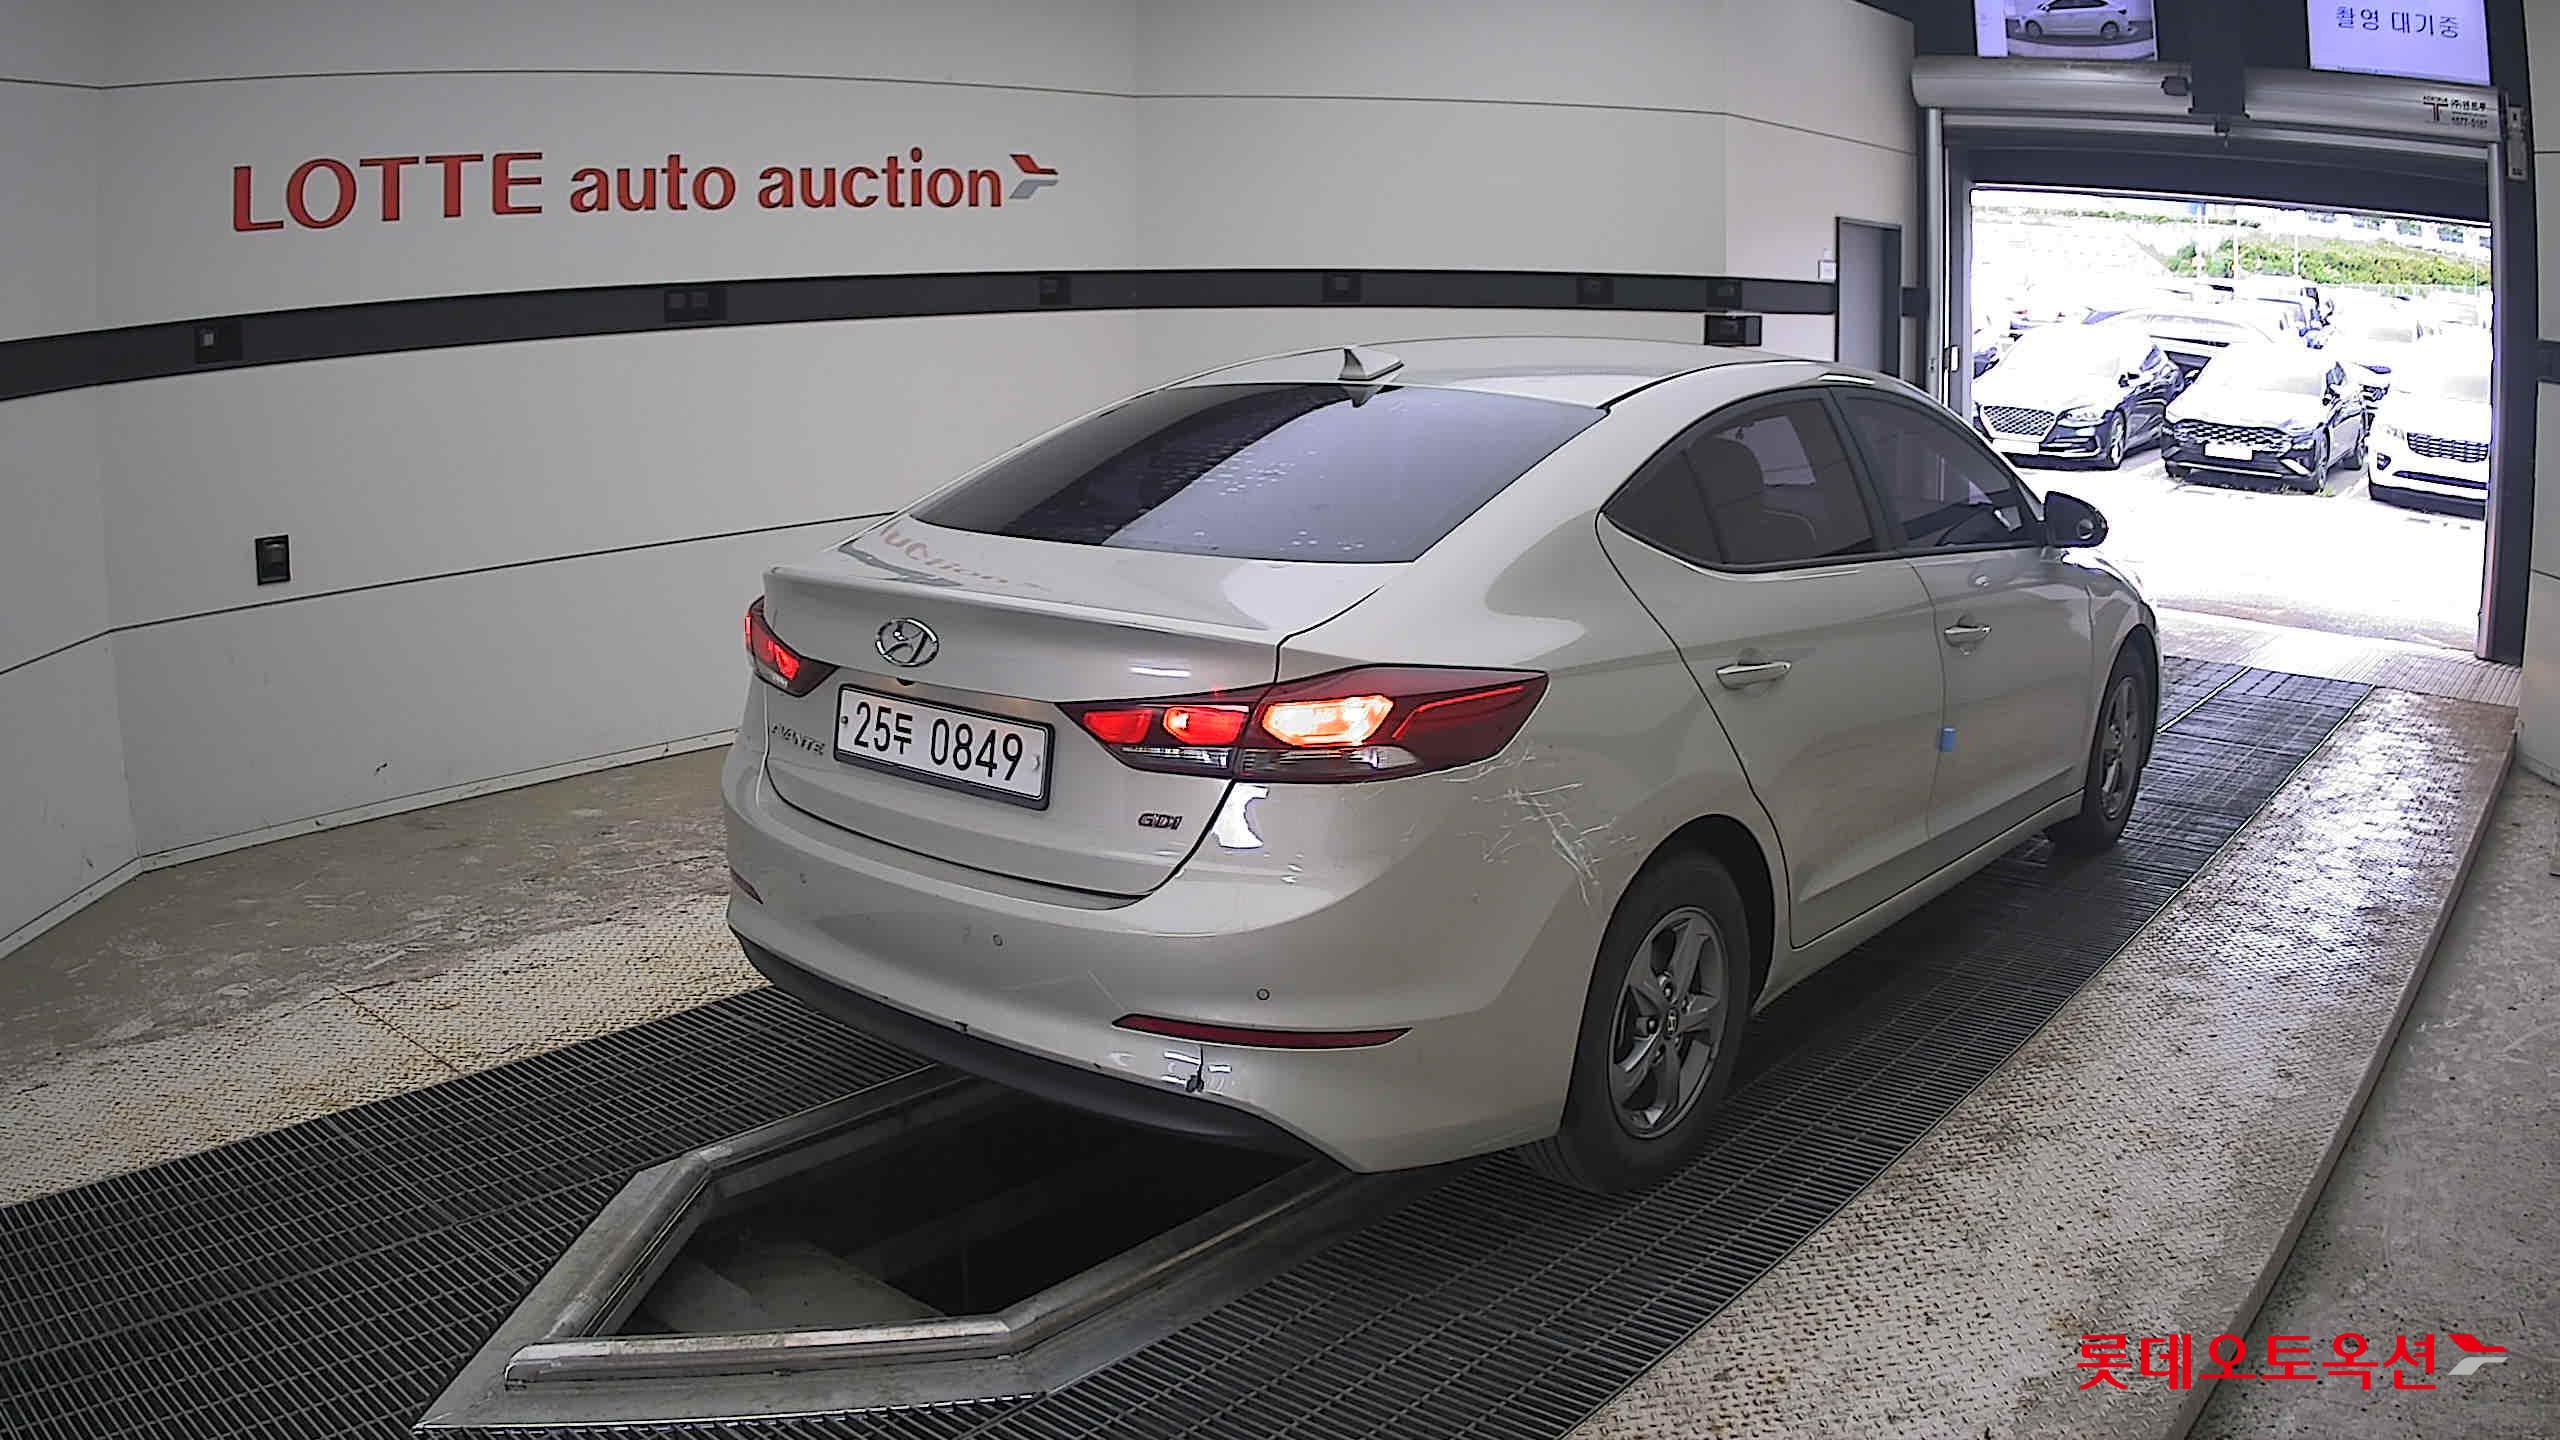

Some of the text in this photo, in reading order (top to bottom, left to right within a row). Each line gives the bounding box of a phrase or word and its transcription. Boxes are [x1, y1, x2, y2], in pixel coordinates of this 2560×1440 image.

[2336, 6, 2459, 39] 촬영 대기중
[233, 147, 1003, 232] LOTTE auto auction
[853, 701, 1024, 782] 25두 0849
